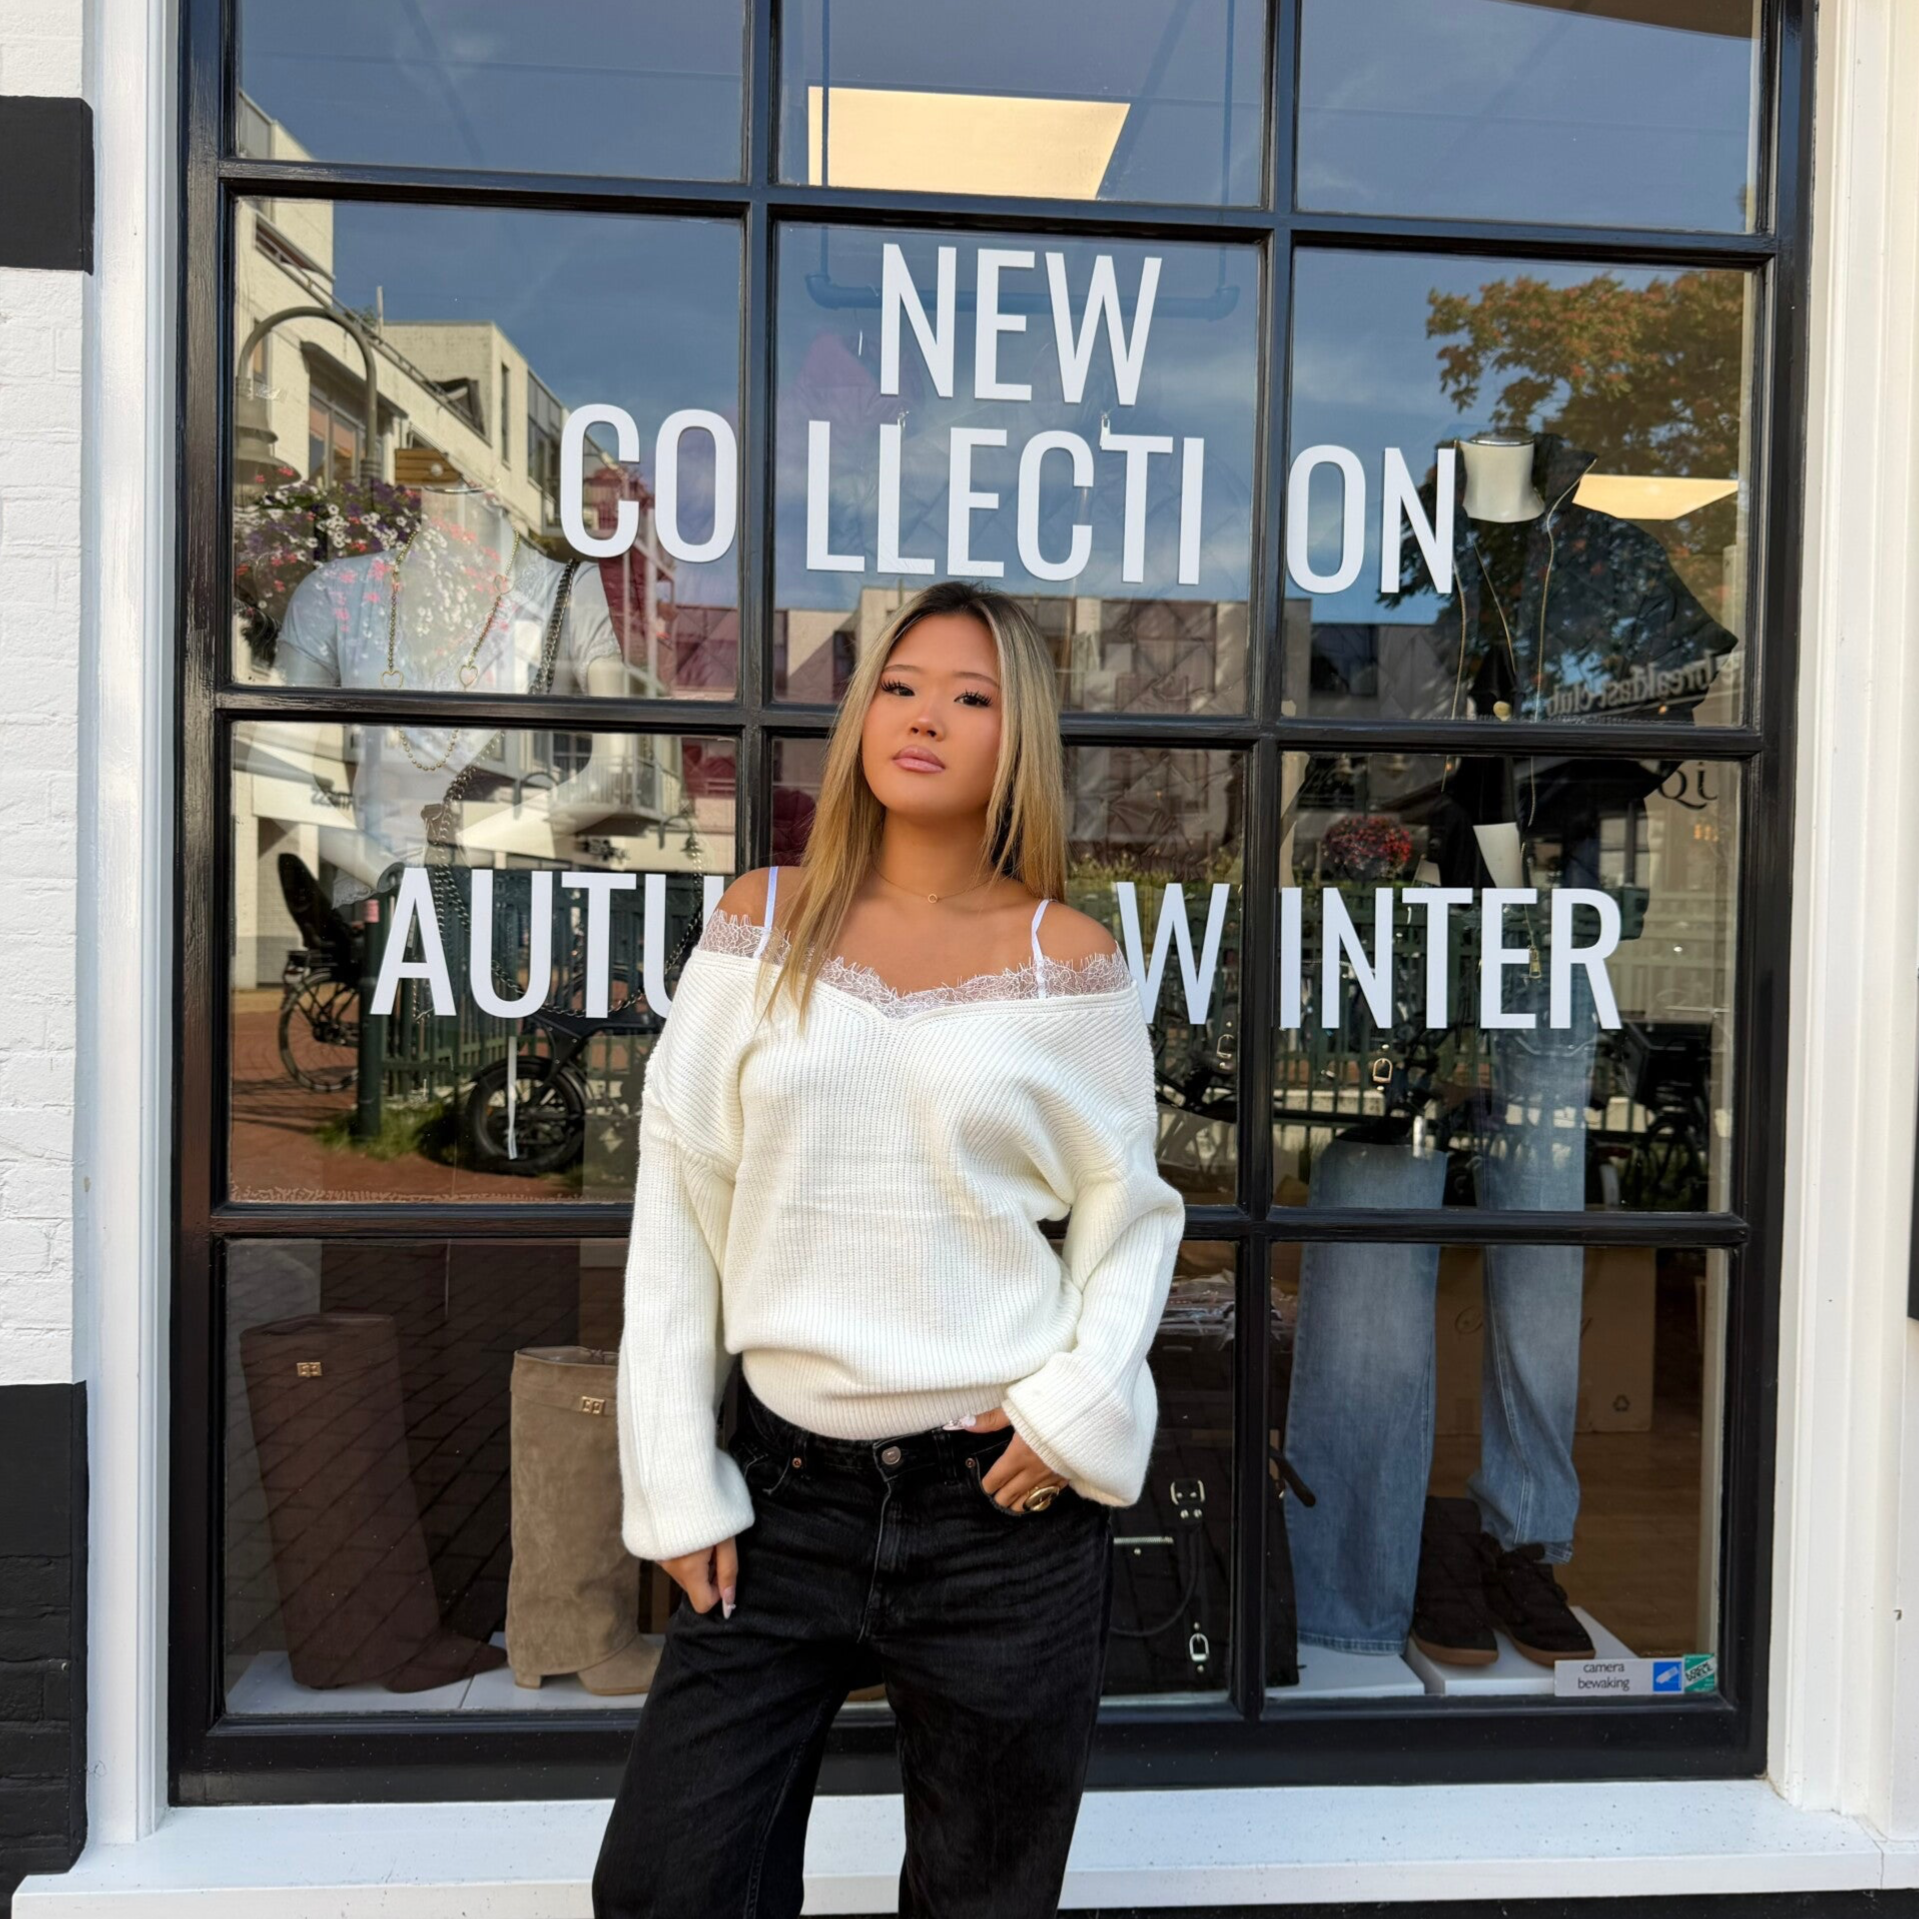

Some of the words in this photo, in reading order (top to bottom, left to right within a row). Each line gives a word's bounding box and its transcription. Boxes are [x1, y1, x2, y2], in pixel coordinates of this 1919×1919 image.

[880, 243, 1163, 406] NEW
[370, 867, 724, 1019] AUTU
[1115, 881, 1623, 1029] WINTER
[1577, 1677, 1630, 1691] bewaking
[1583, 1662, 1625, 1673] camera
